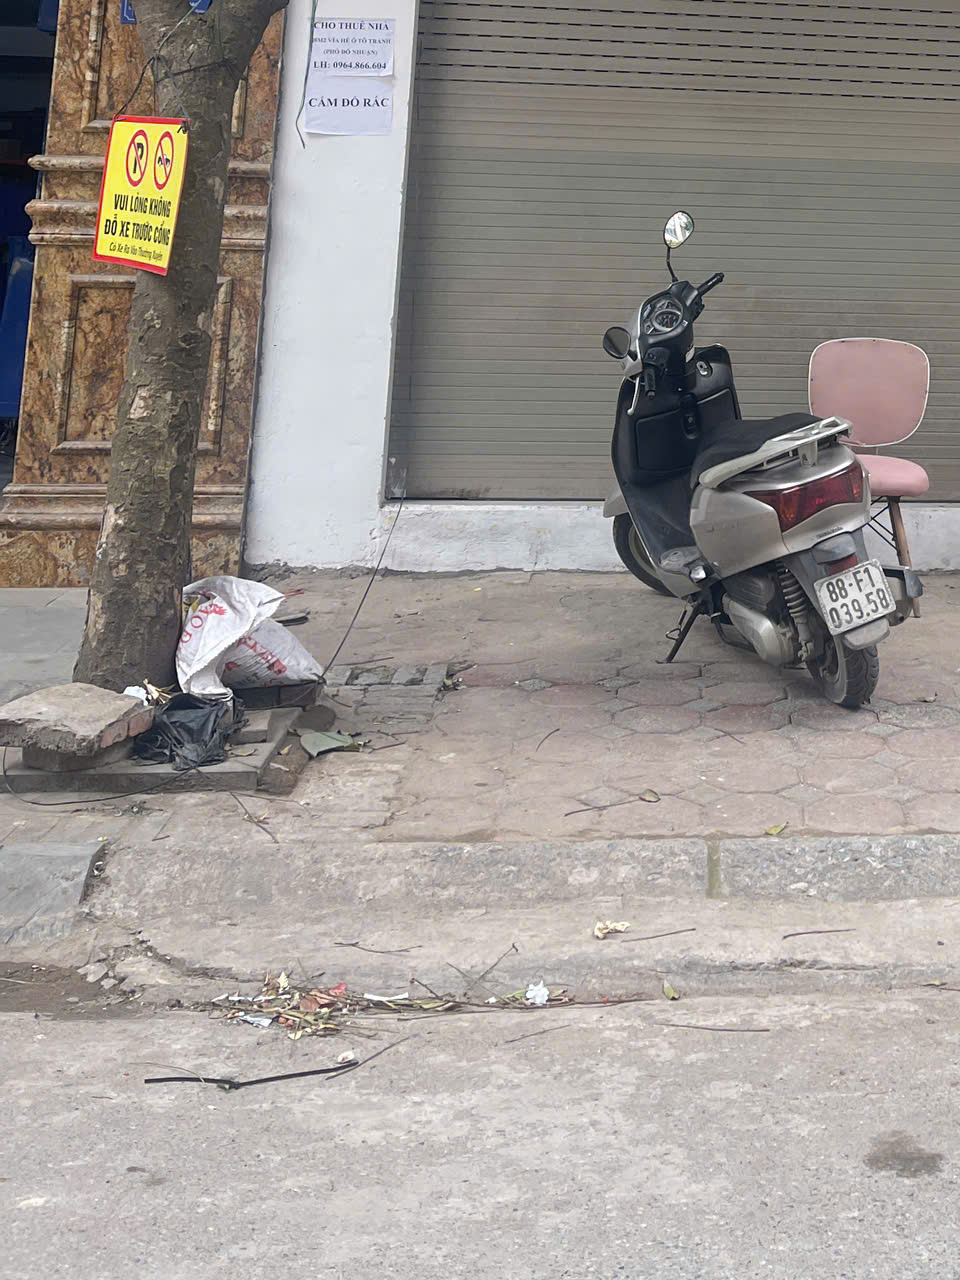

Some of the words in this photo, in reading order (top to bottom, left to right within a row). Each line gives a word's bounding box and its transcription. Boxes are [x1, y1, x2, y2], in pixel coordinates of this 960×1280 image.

[313, 21, 336, 30] CHO
[338, 20, 366, 30] THUÊ
[368, 20, 389, 31] NHÀ
[313, 61, 330, 69] LH:
[332, 61, 387, 70] 0964.866.604
[363, 95, 390, 107] RÁC
[114, 193, 129, 211] VUI
[130, 192, 148, 214] LÒNG
[148, 196, 171, 218] KHÔNG
[104, 213, 118, 236] ĐỖ
[119, 220, 130, 238] XE
[131, 221, 153, 242] TRƯỚC
[153, 221, 171, 246] CỔNG
[117, 242, 124, 253] Xe
[826, 567, 876, 603] 88-F1
[828, 588, 890, 629] 039.58
